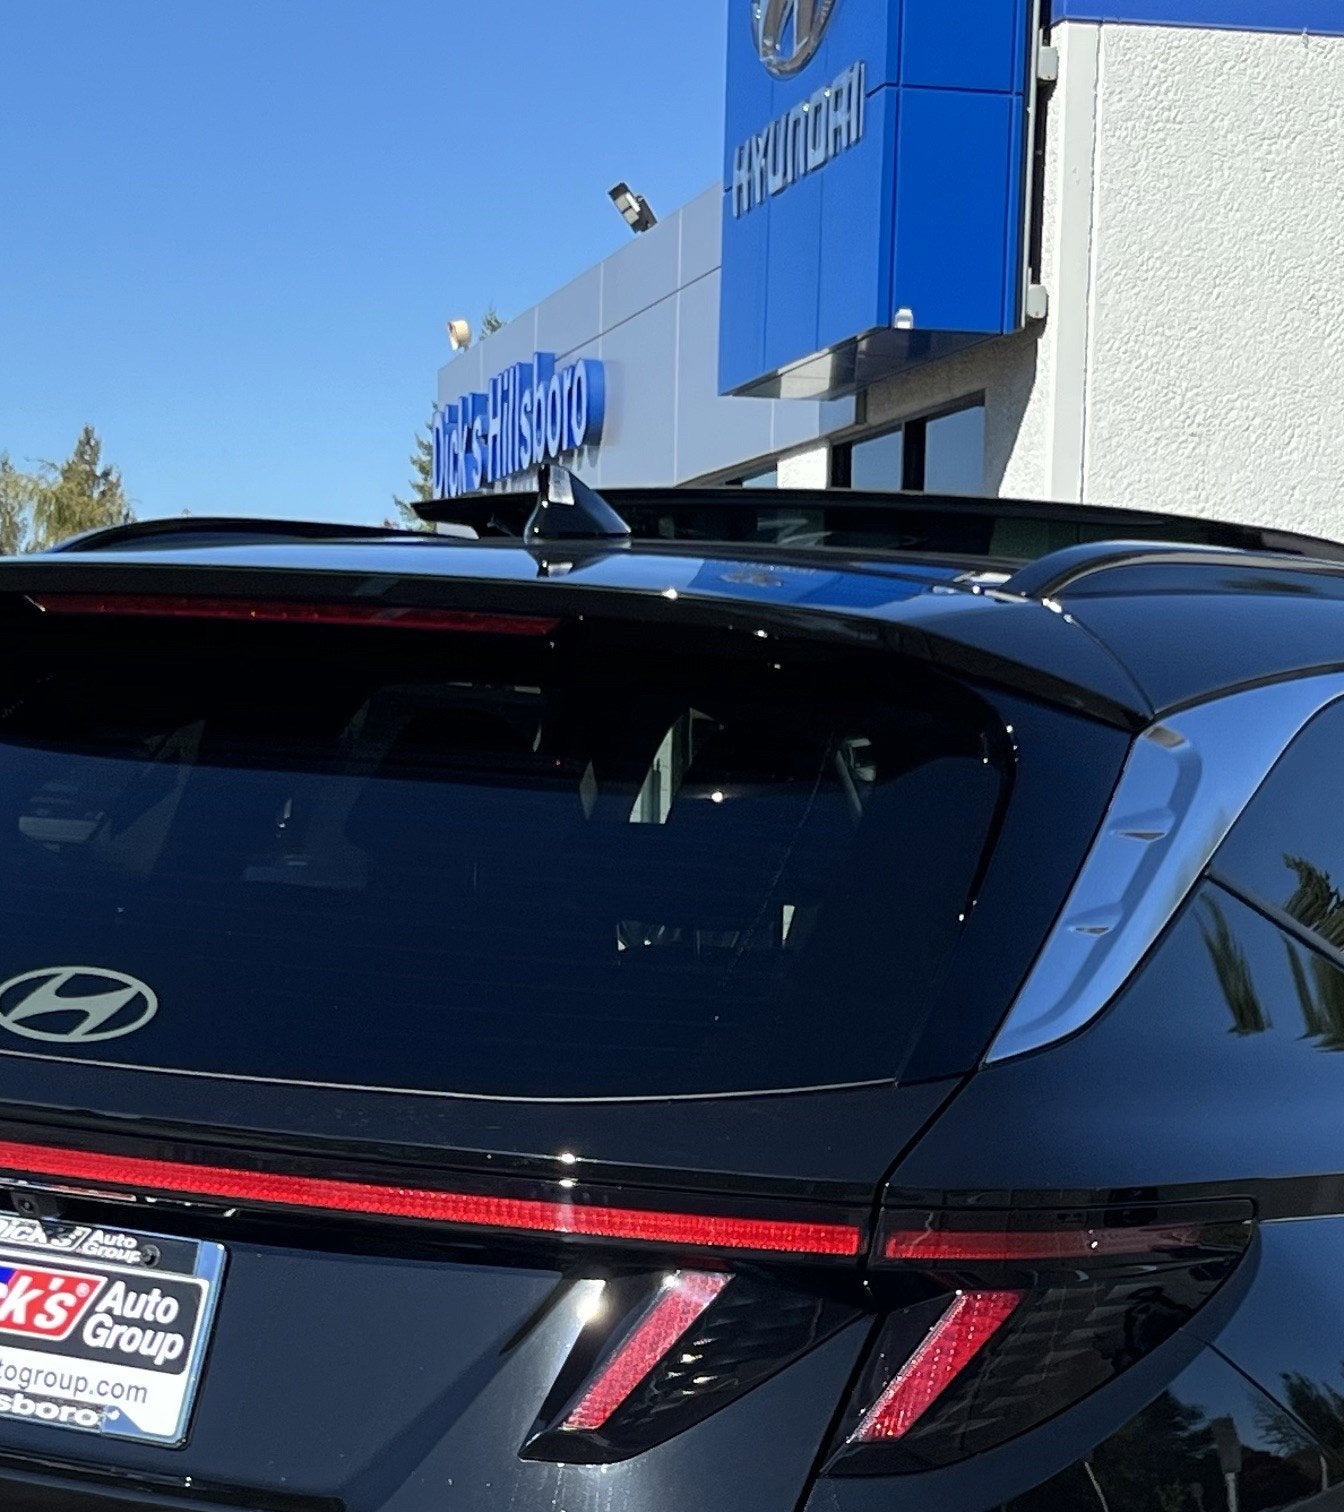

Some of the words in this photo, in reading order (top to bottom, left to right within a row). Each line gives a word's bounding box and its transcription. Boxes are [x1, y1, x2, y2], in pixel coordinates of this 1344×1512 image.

[732, 60, 866, 219] HYUNDAI
[432, 392, 483, 499] Dick's
[487, 352, 589, 483] Hillsboro
[89, 1229, 138, 1249] Auto
[94, 1280, 179, 1324] Auto
[83, 1314, 184, 1365] Group
